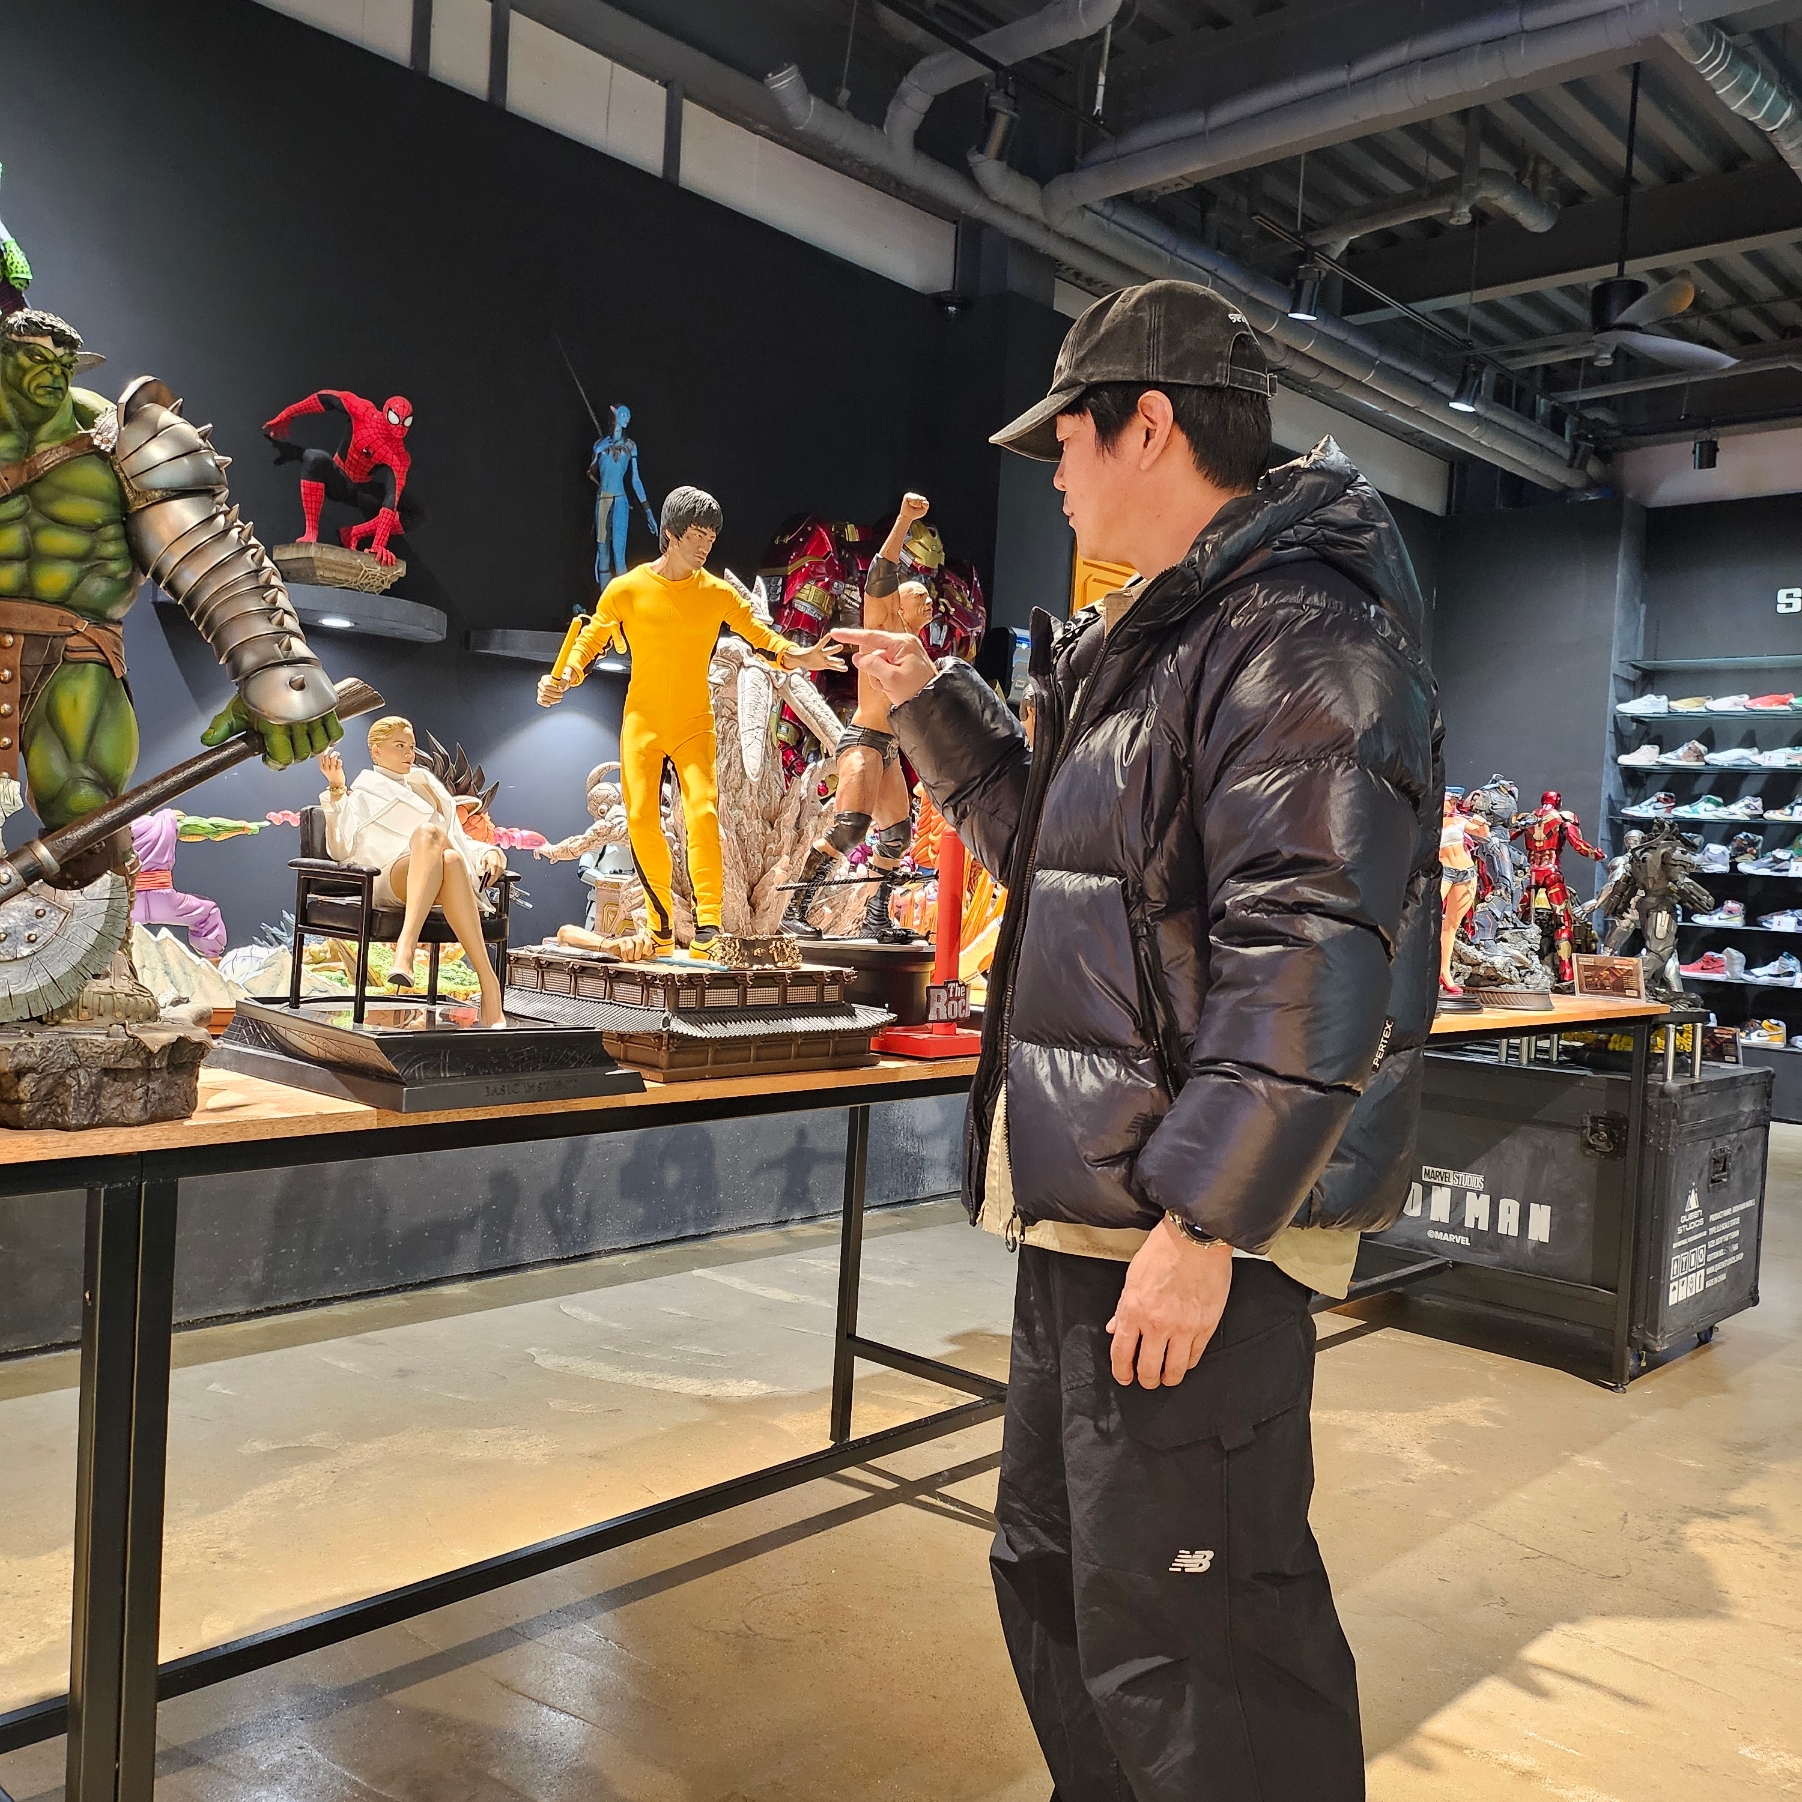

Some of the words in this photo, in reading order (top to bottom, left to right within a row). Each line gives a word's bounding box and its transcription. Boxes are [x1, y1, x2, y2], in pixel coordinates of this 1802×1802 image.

[1777, 588, 1802, 614] S
[948, 983, 966, 998] The
[1372, 1019, 1394, 1068] PERTEX
[485, 1083, 519, 1097] BASIC
[1423, 1167, 1452, 1185] MARVEL
[1452, 1171, 1485, 1191] STUDIOS
[1464, 1191, 1551, 1243] MAN
